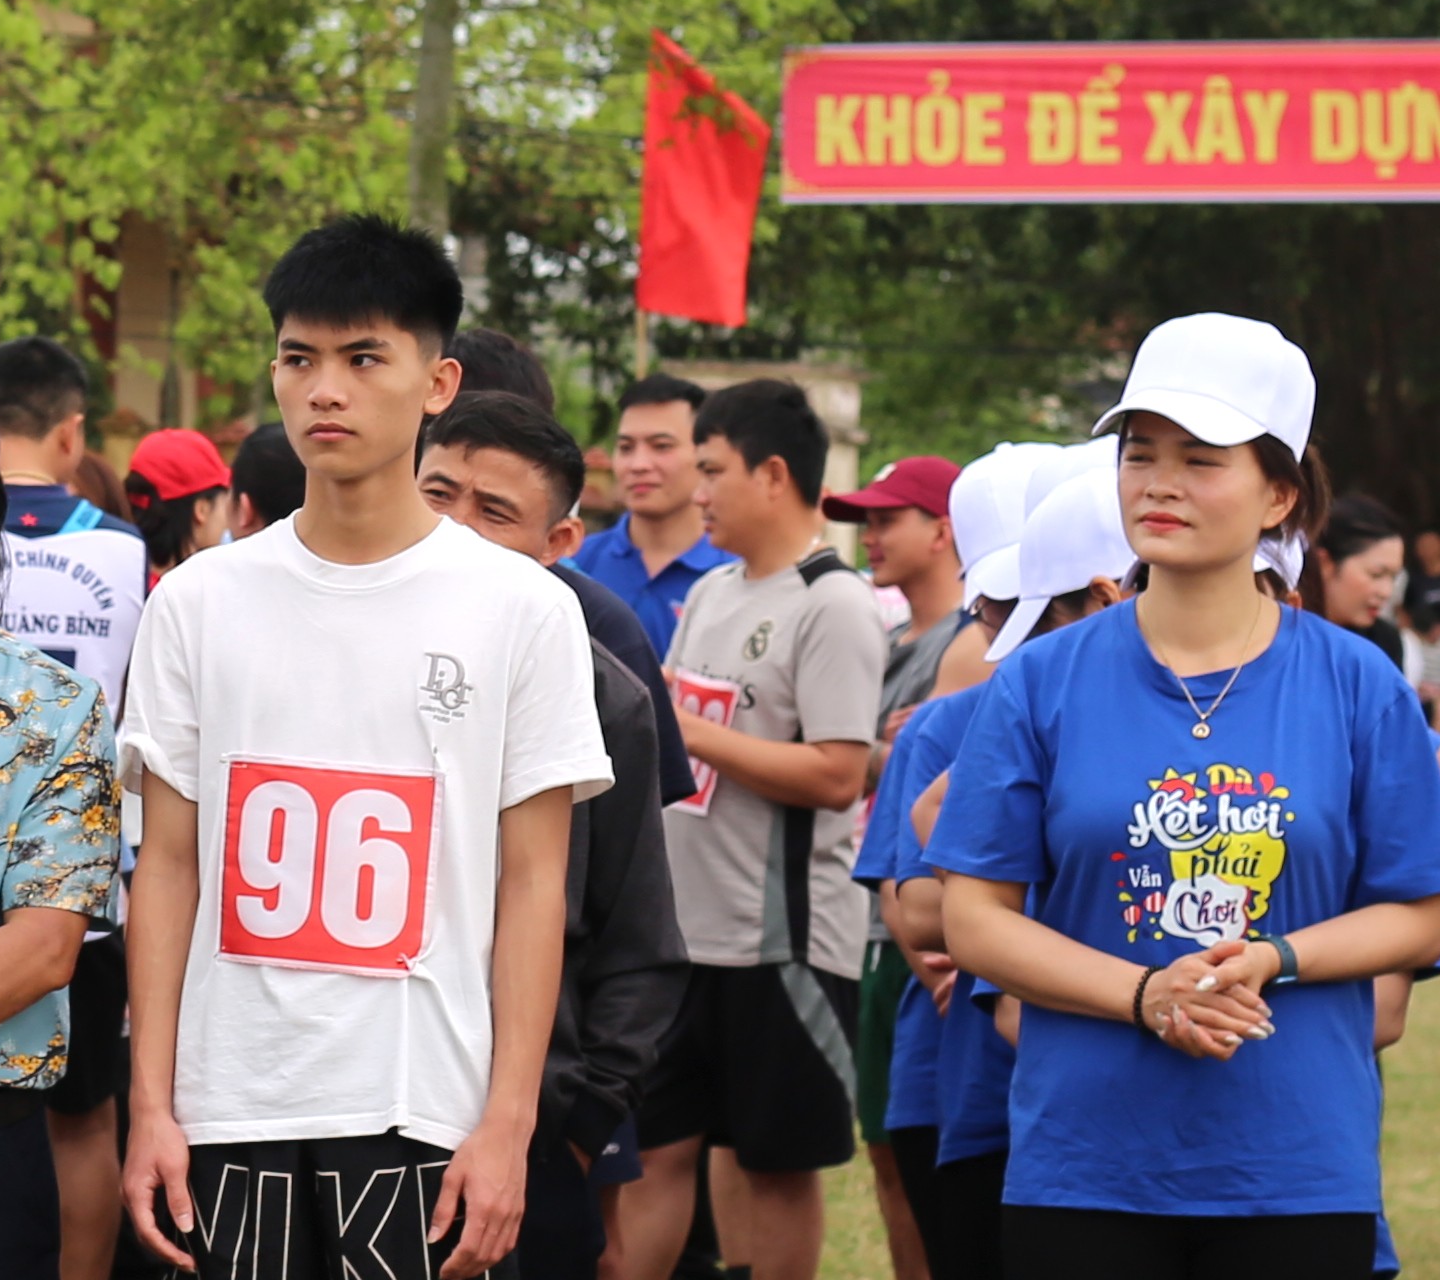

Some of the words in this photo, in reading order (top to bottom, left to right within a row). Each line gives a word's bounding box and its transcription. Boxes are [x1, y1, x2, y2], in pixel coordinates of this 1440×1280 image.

[815, 69, 1005, 167] KHỎE
[1027, 63, 1126, 166] ĐỂ
[1143, 74, 1288, 165] XÂY
[0, 606, 59, 634] UẢNG
[64, 610, 111, 637] BÌNH
[1128, 789, 1219, 850] Hết
[1217, 793, 1285, 839] hơi
[235, 780, 413, 948] 96
[1129, 865, 1163, 889] Vẫn
[1174, 890, 1239, 938] Chơi
